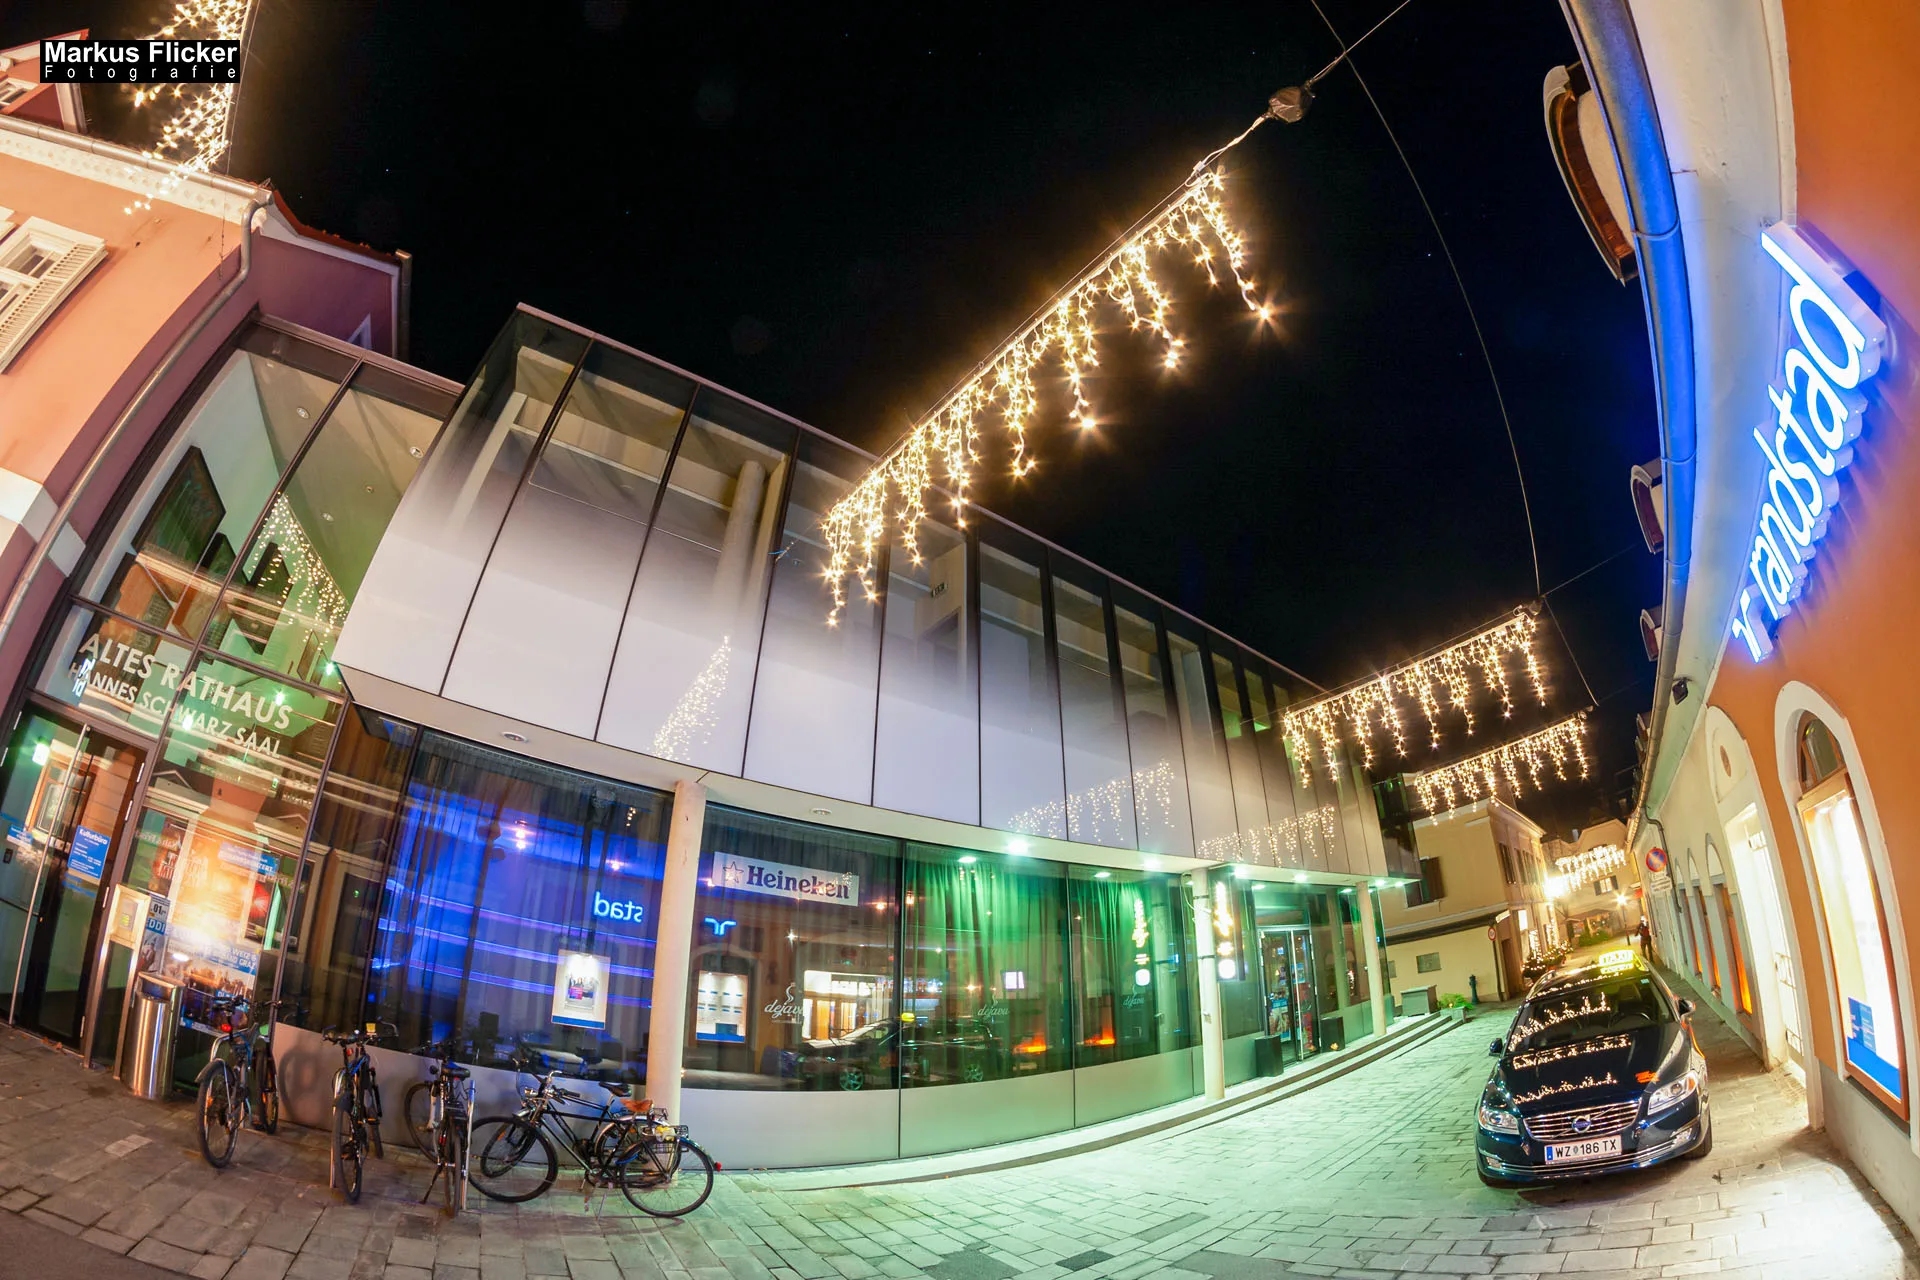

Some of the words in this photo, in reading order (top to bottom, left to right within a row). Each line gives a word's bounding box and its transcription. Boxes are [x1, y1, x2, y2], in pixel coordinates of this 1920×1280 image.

[1749, 231, 1867, 621] randstad
[68, 662, 138, 704] HANNES
[235, 726, 280, 759] SAAL
[80, 633, 155, 679] ALTES
[160, 662, 293, 730] RATHAUS
[746, 865, 850, 899] Heineken
[1555, 1146, 1571, 1158] WZ
[1580, 1142, 1600, 1155] 186
[1603, 1139, 1617, 1151] TX
